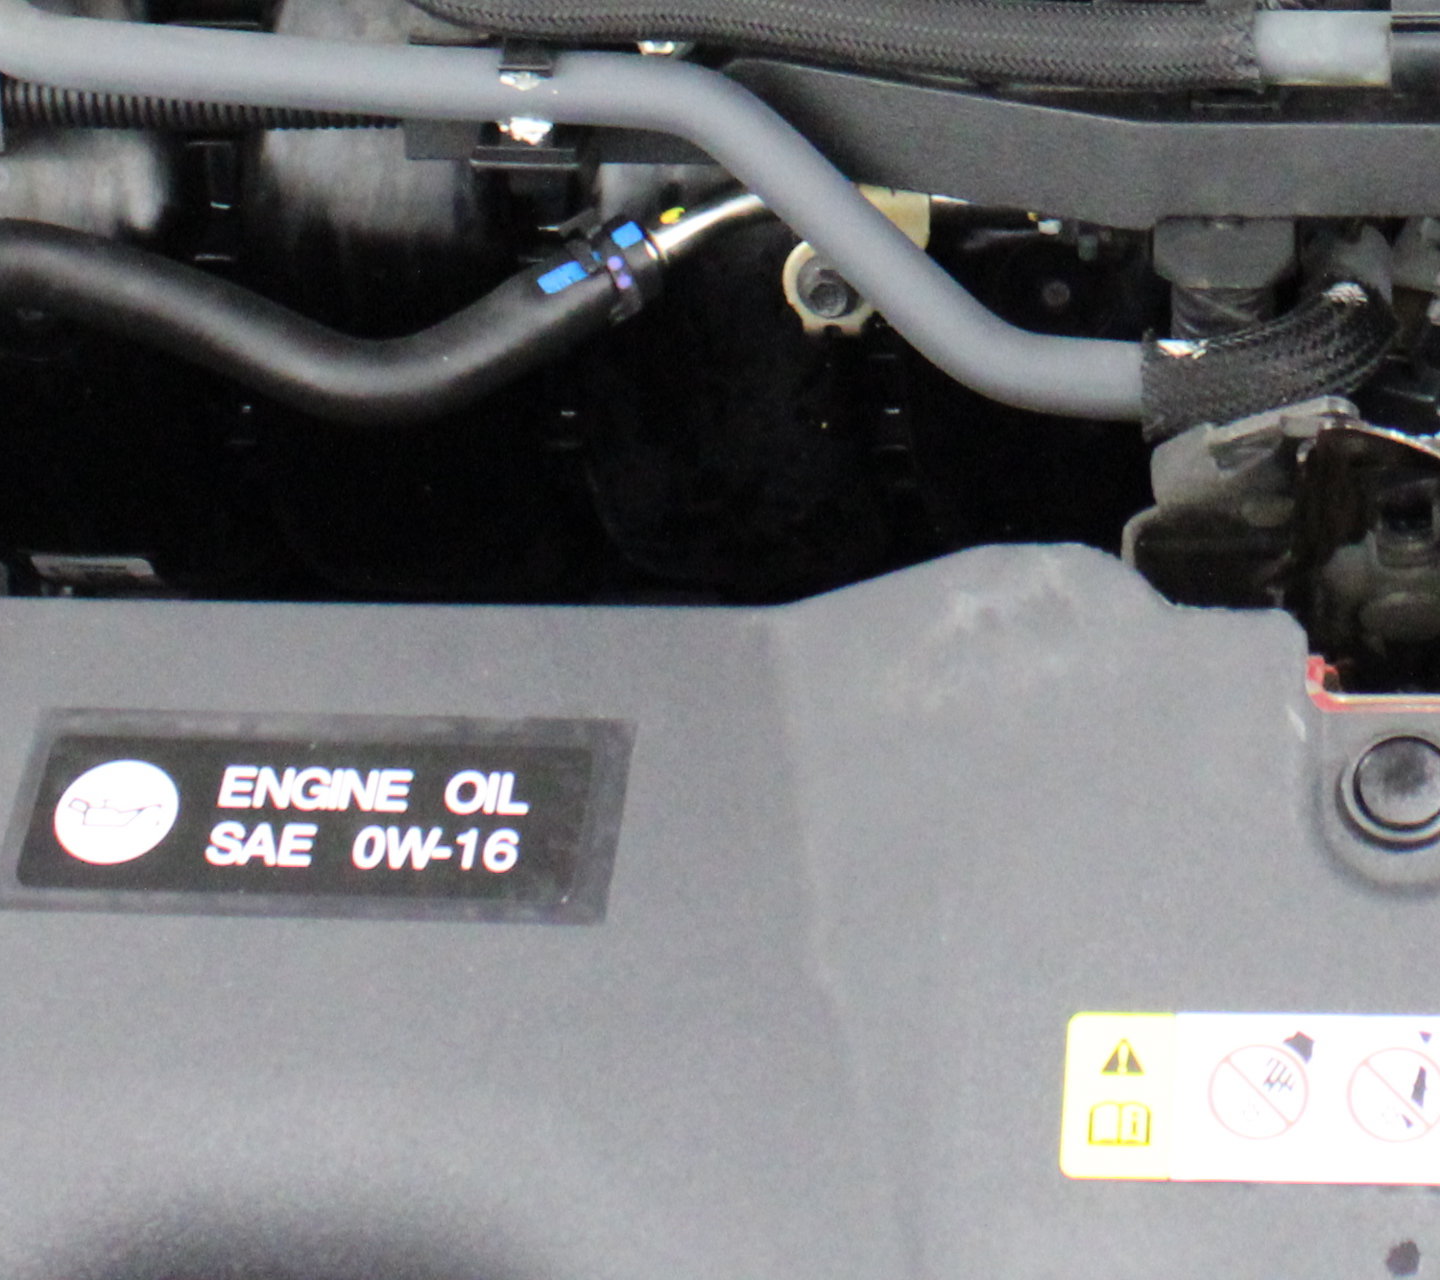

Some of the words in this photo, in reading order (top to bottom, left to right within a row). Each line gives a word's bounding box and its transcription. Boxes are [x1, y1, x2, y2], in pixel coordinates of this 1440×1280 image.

[216, 765, 416, 813] ENGINE
[444, 769, 530, 816] OIL
[204, 820, 319, 868] SAE
[351, 824, 521, 874] 0W-16
